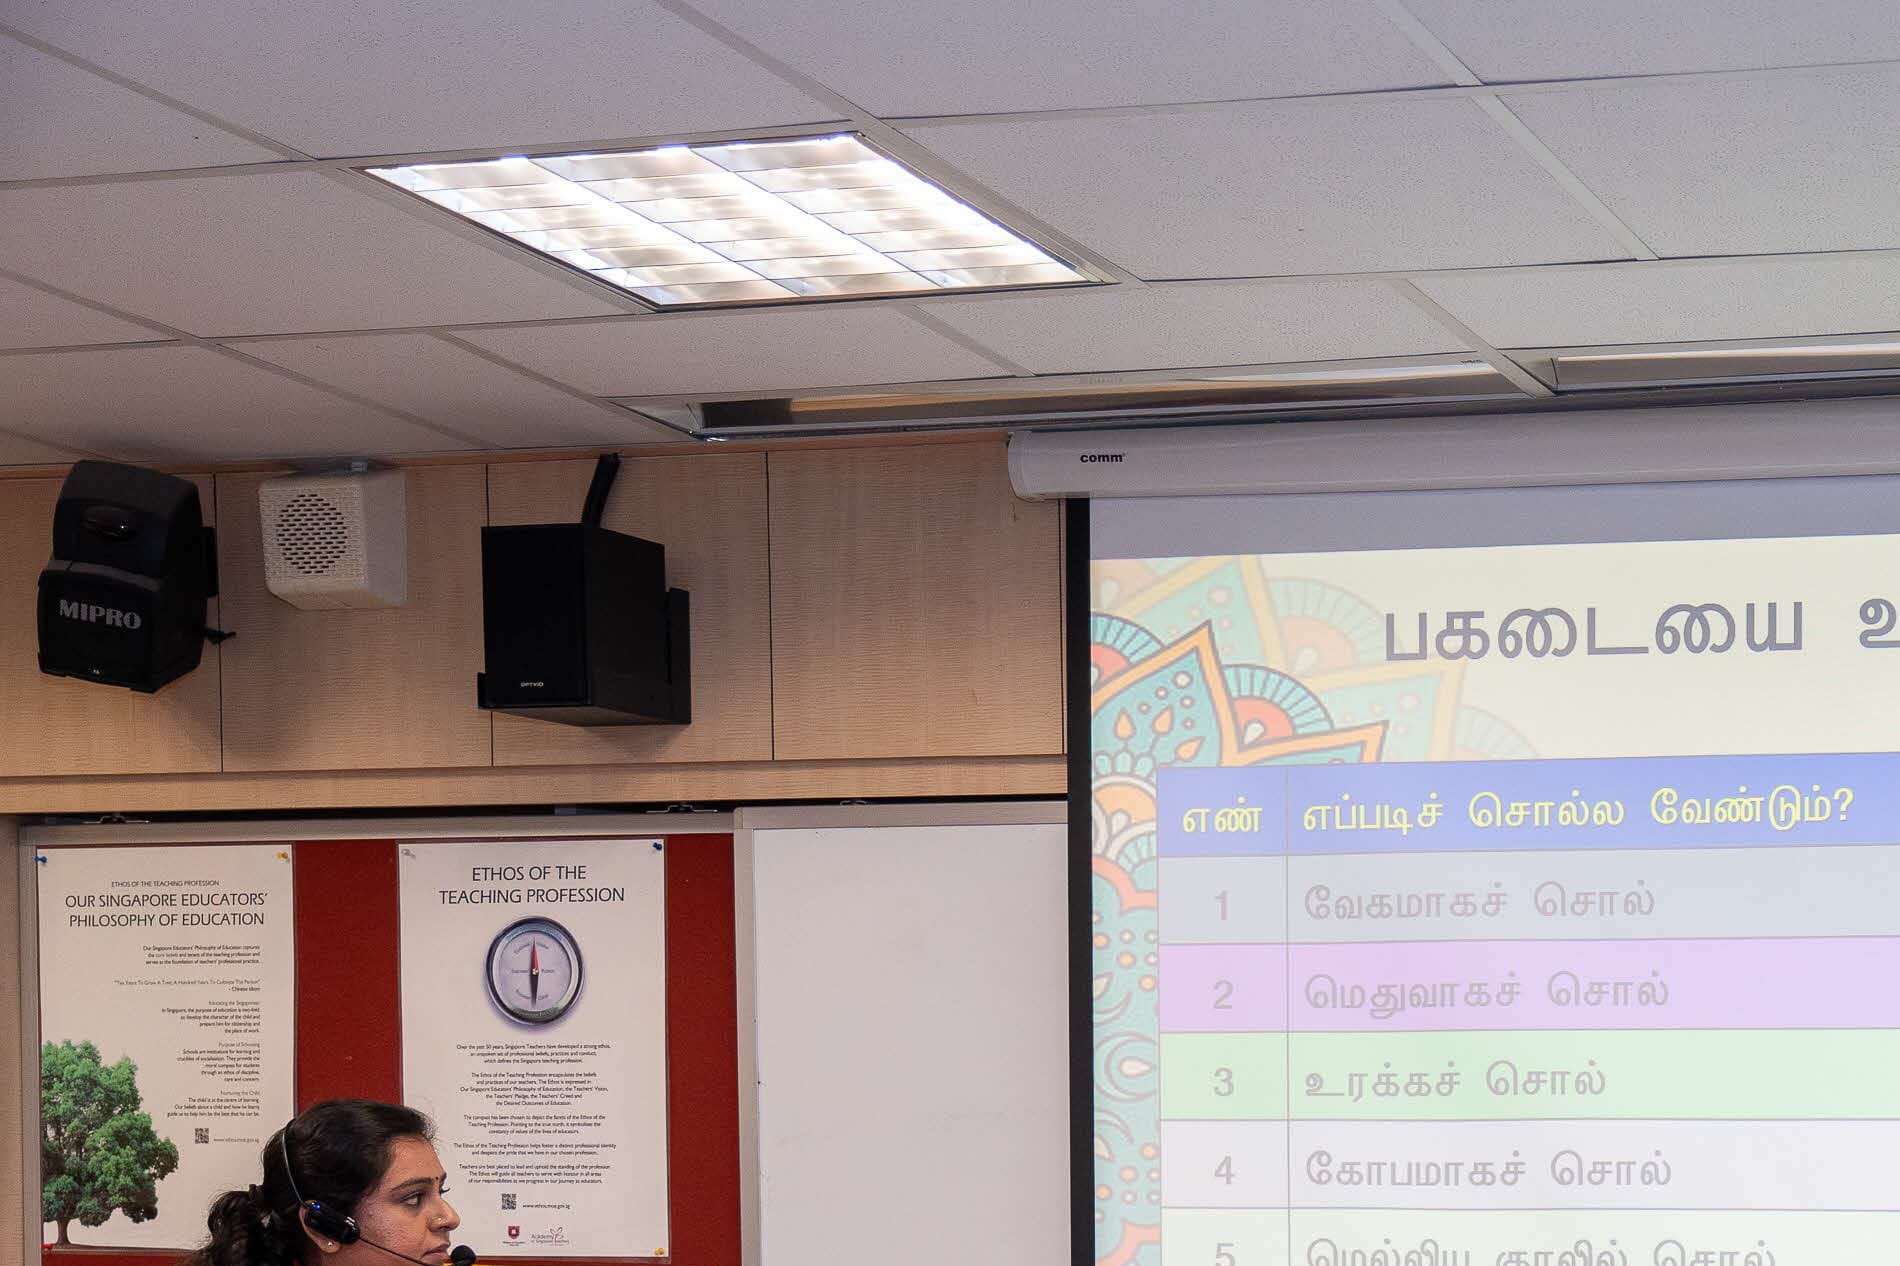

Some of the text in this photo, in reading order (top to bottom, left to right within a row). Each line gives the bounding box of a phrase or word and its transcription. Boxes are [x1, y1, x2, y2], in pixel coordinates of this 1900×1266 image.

[1079, 453, 1123, 464] comm
[60, 599, 141, 629] MIPRO
[1386, 601, 1802, 661] பகடையை
[1183, 797, 1262, 832] எண்
[1303, 785, 1853, 835] எப்படிச் சொல்ல வேண்டும்?
[472, 865, 587, 881] ETHOS OF THE
[65, 895, 95, 908] OUR
[99, 894, 177, 907] SINGAPORE
[439, 887, 625, 905] TEACHING PROFESSION
[1215, 890, 1227, 920] 1
[1305, 880, 1655, 920] வேகமாகச் சொல்
[69, 912, 265, 927] PHILOSOPHY OF EDUCATION
[1213, 980, 1233, 1009] 2
[1305, 970, 1669, 1020] மெதுவாகச் சொல்
[1214, 1067, 1234, 1096] 3
[1305, 1060, 1605, 1102] உரக்கச் சொல்
[1214, 1156, 1235, 1185] 4
[1306, 1150, 1671, 1186] கோபமாகச் சொல்
